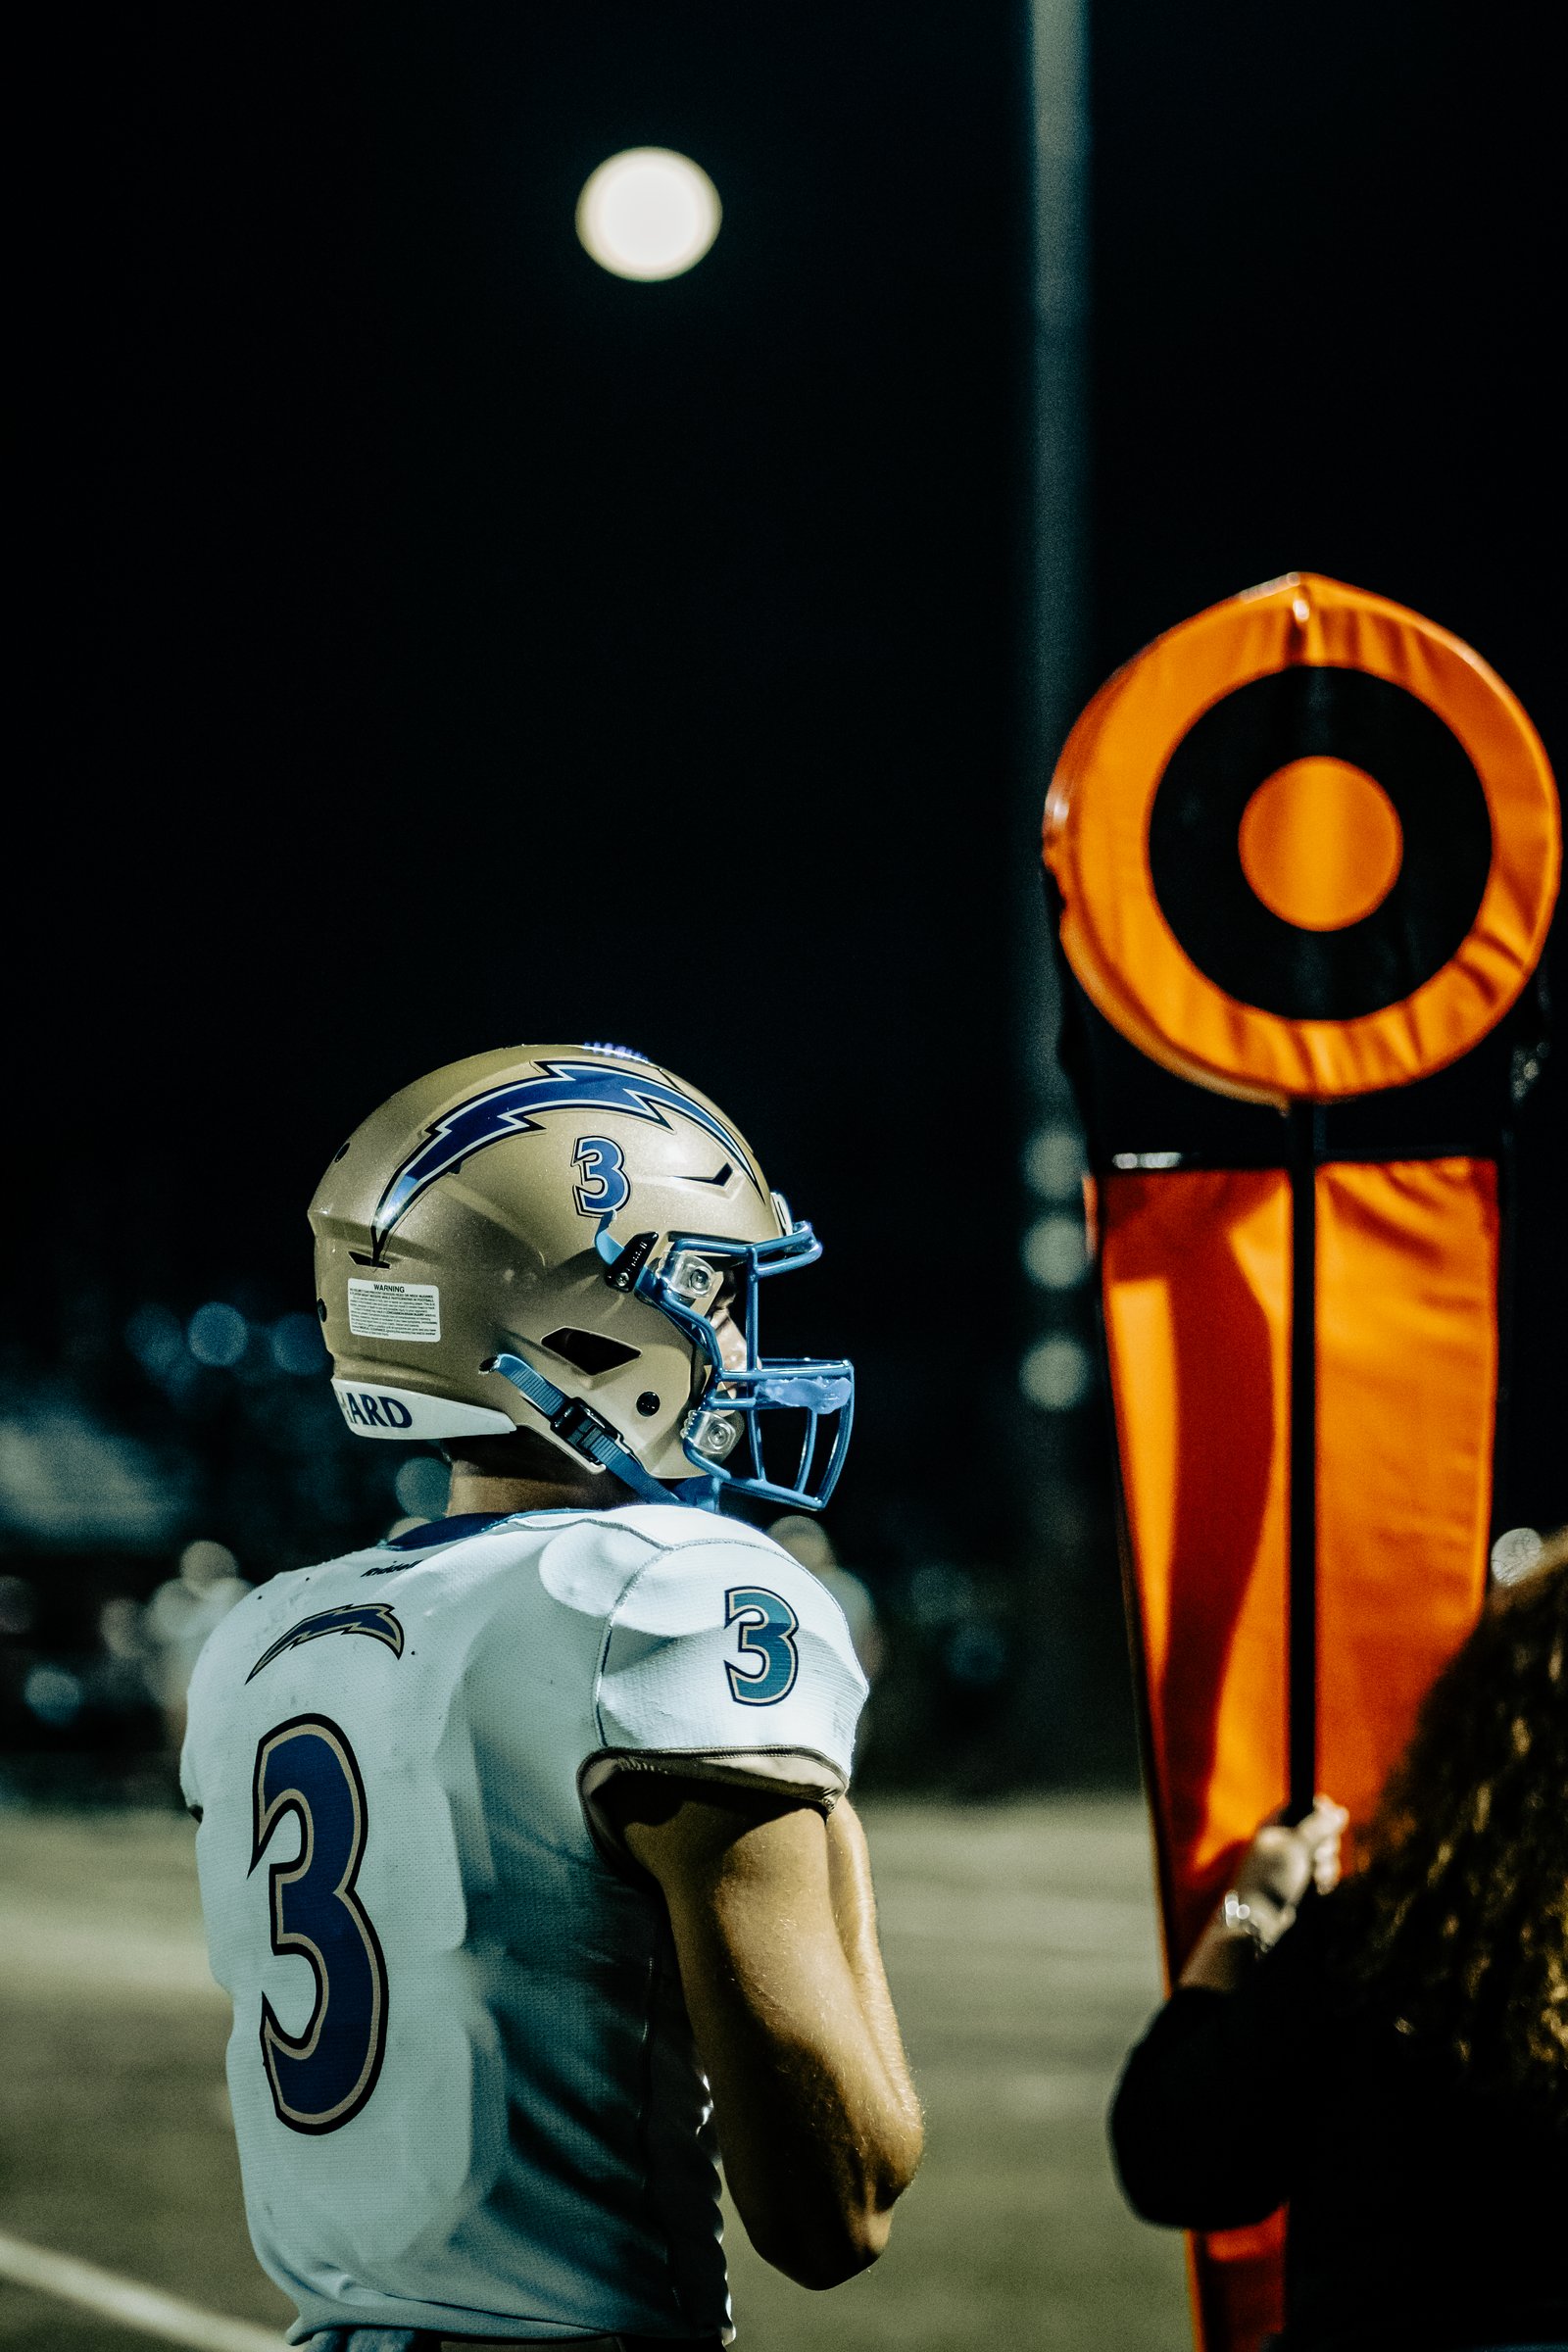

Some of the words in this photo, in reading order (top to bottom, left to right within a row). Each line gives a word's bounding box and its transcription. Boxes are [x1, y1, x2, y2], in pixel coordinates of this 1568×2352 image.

[571, 1135, 631, 1218] 3
[373, 1284, 405, 1294] WARNING
[723, 1586, 799, 1706] 3
[247, 1713, 389, 2135] 3
